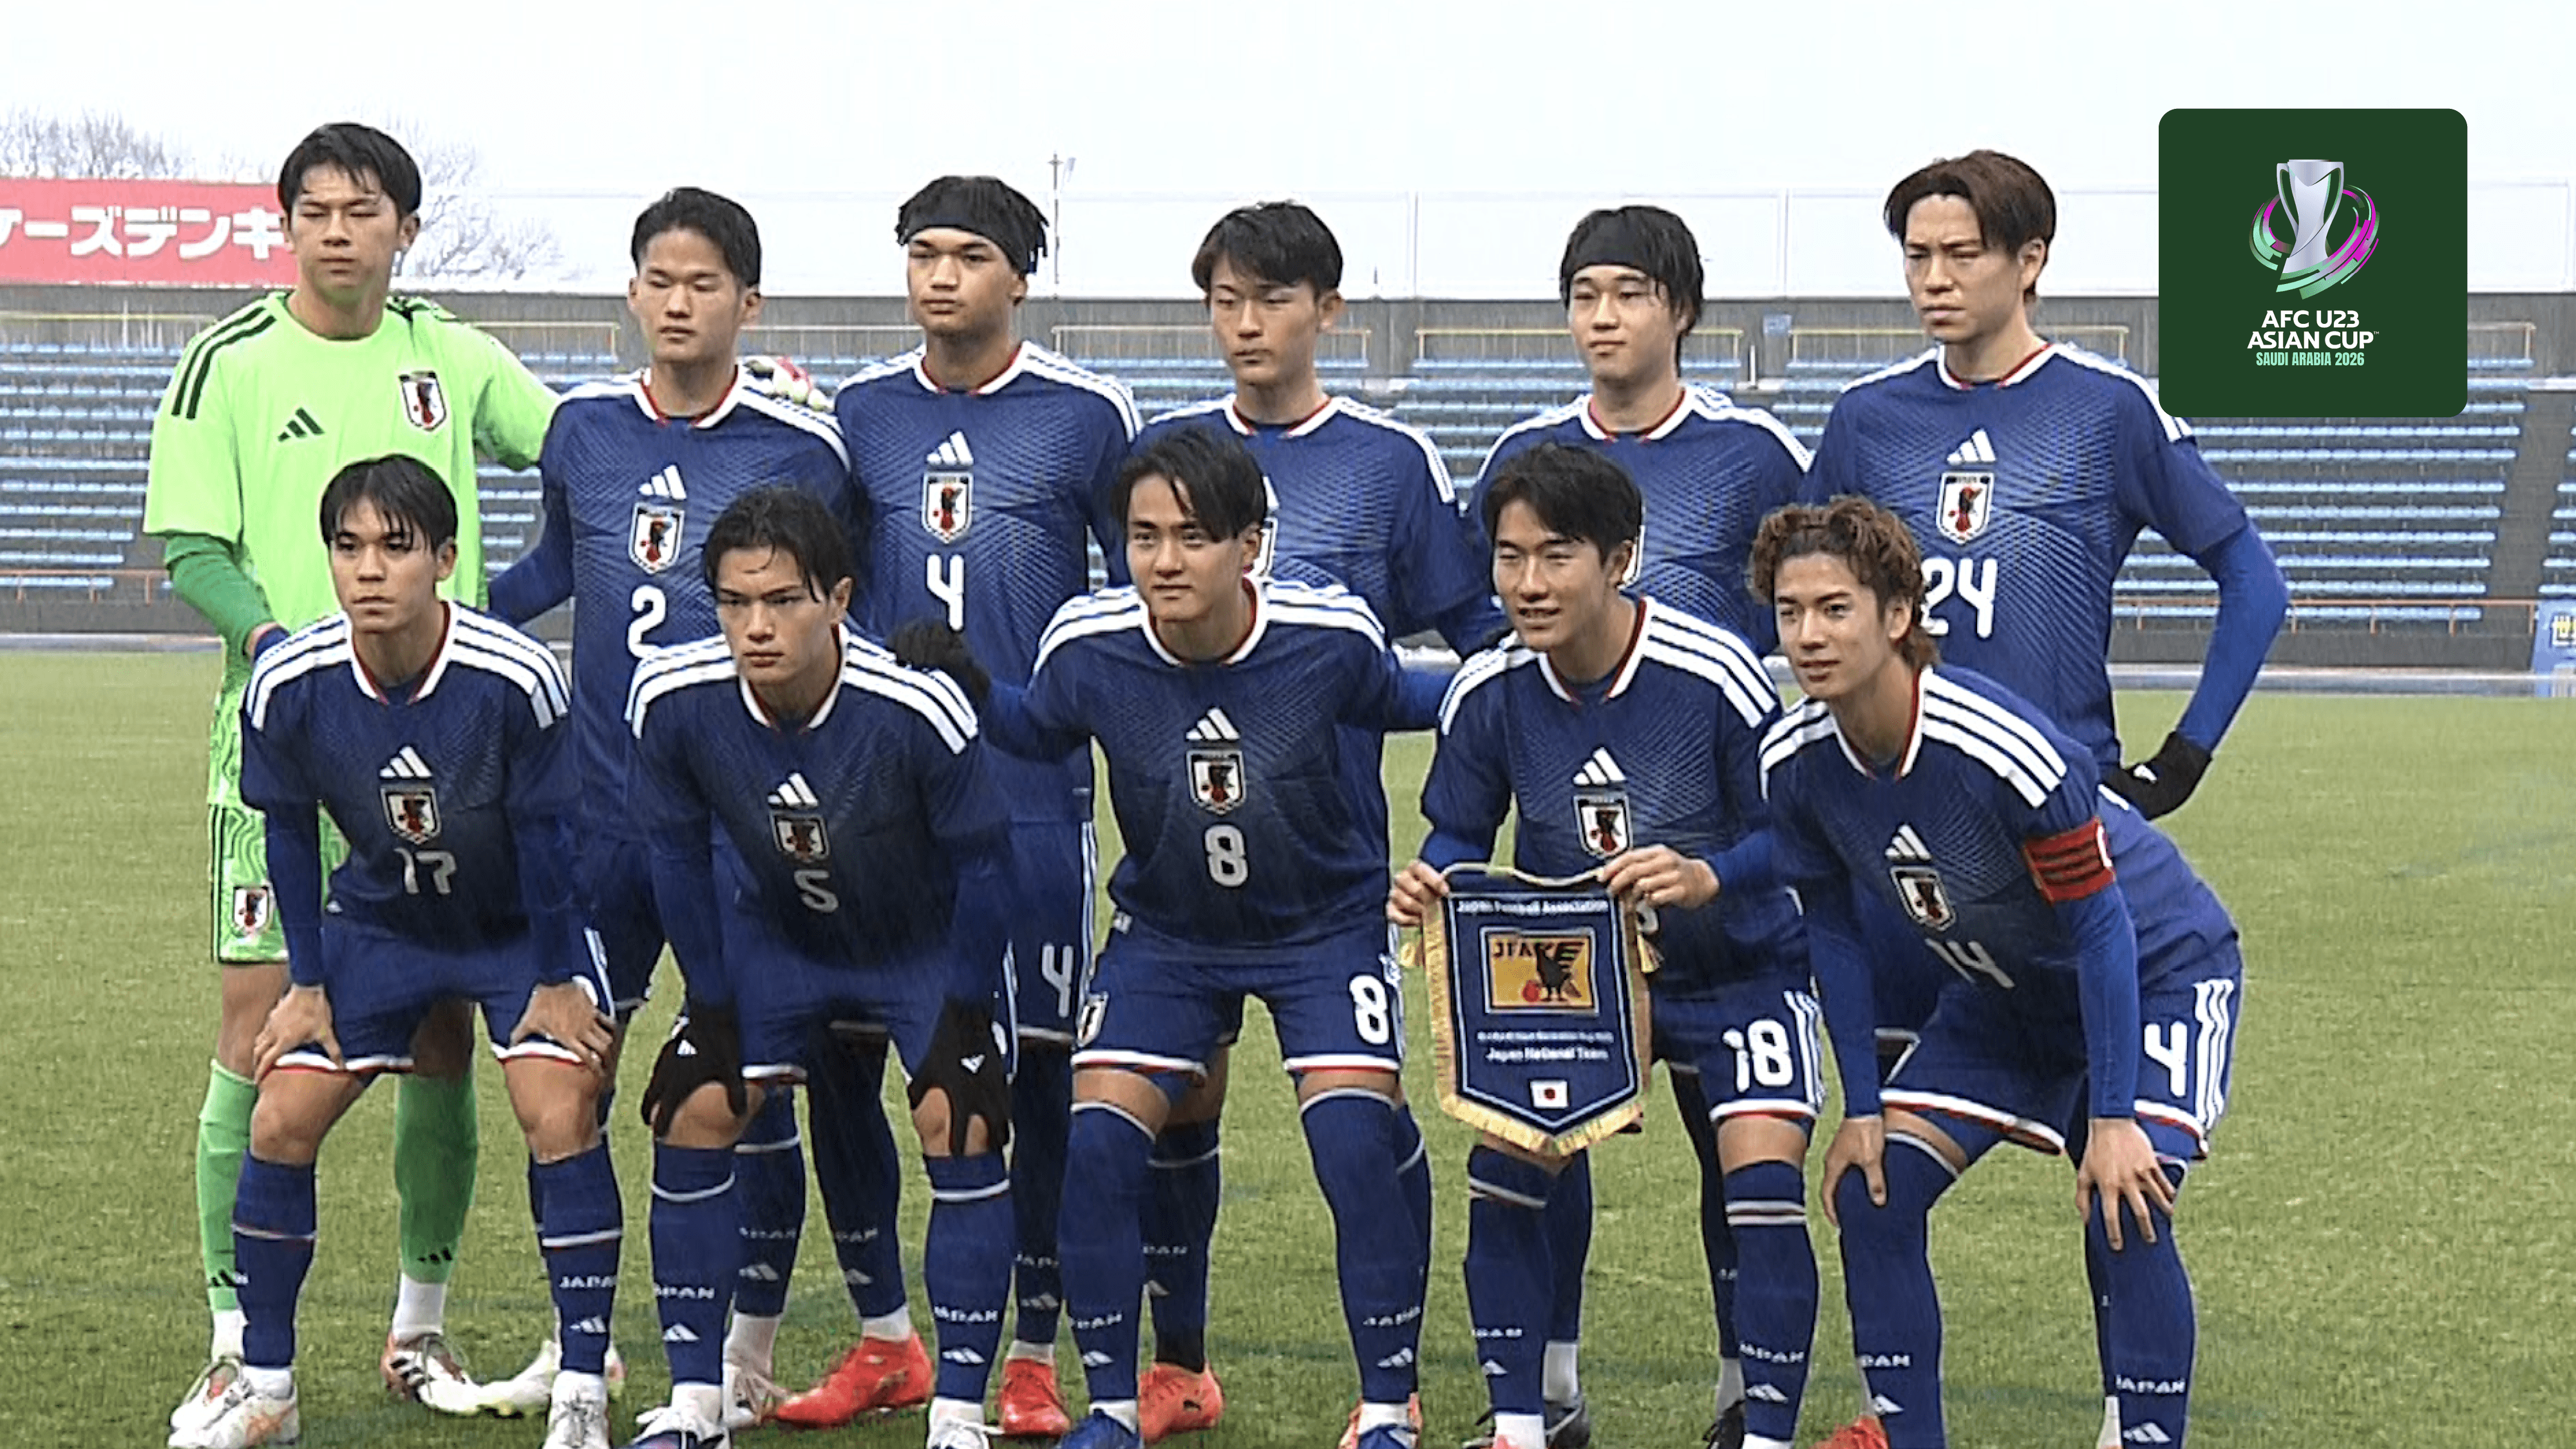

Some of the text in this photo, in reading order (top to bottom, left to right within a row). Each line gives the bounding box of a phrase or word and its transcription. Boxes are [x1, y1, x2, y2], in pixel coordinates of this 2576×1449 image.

[627, 585, 667, 658] 2
[926, 553, 964, 631] 4
[1920, 556, 1997, 639] 24
[393, 847, 457, 895] 17
[793, 869, 838, 913] 5
[1204, 823, 1248, 887] 8
[1041, 942, 1074, 1018] 4
[1924, 938, 2015, 989] 14
[1349, 974, 1390, 1045] 8
[1722, 1019, 1794, 1093] 18
[2143, 1021, 2188, 1097] 4
